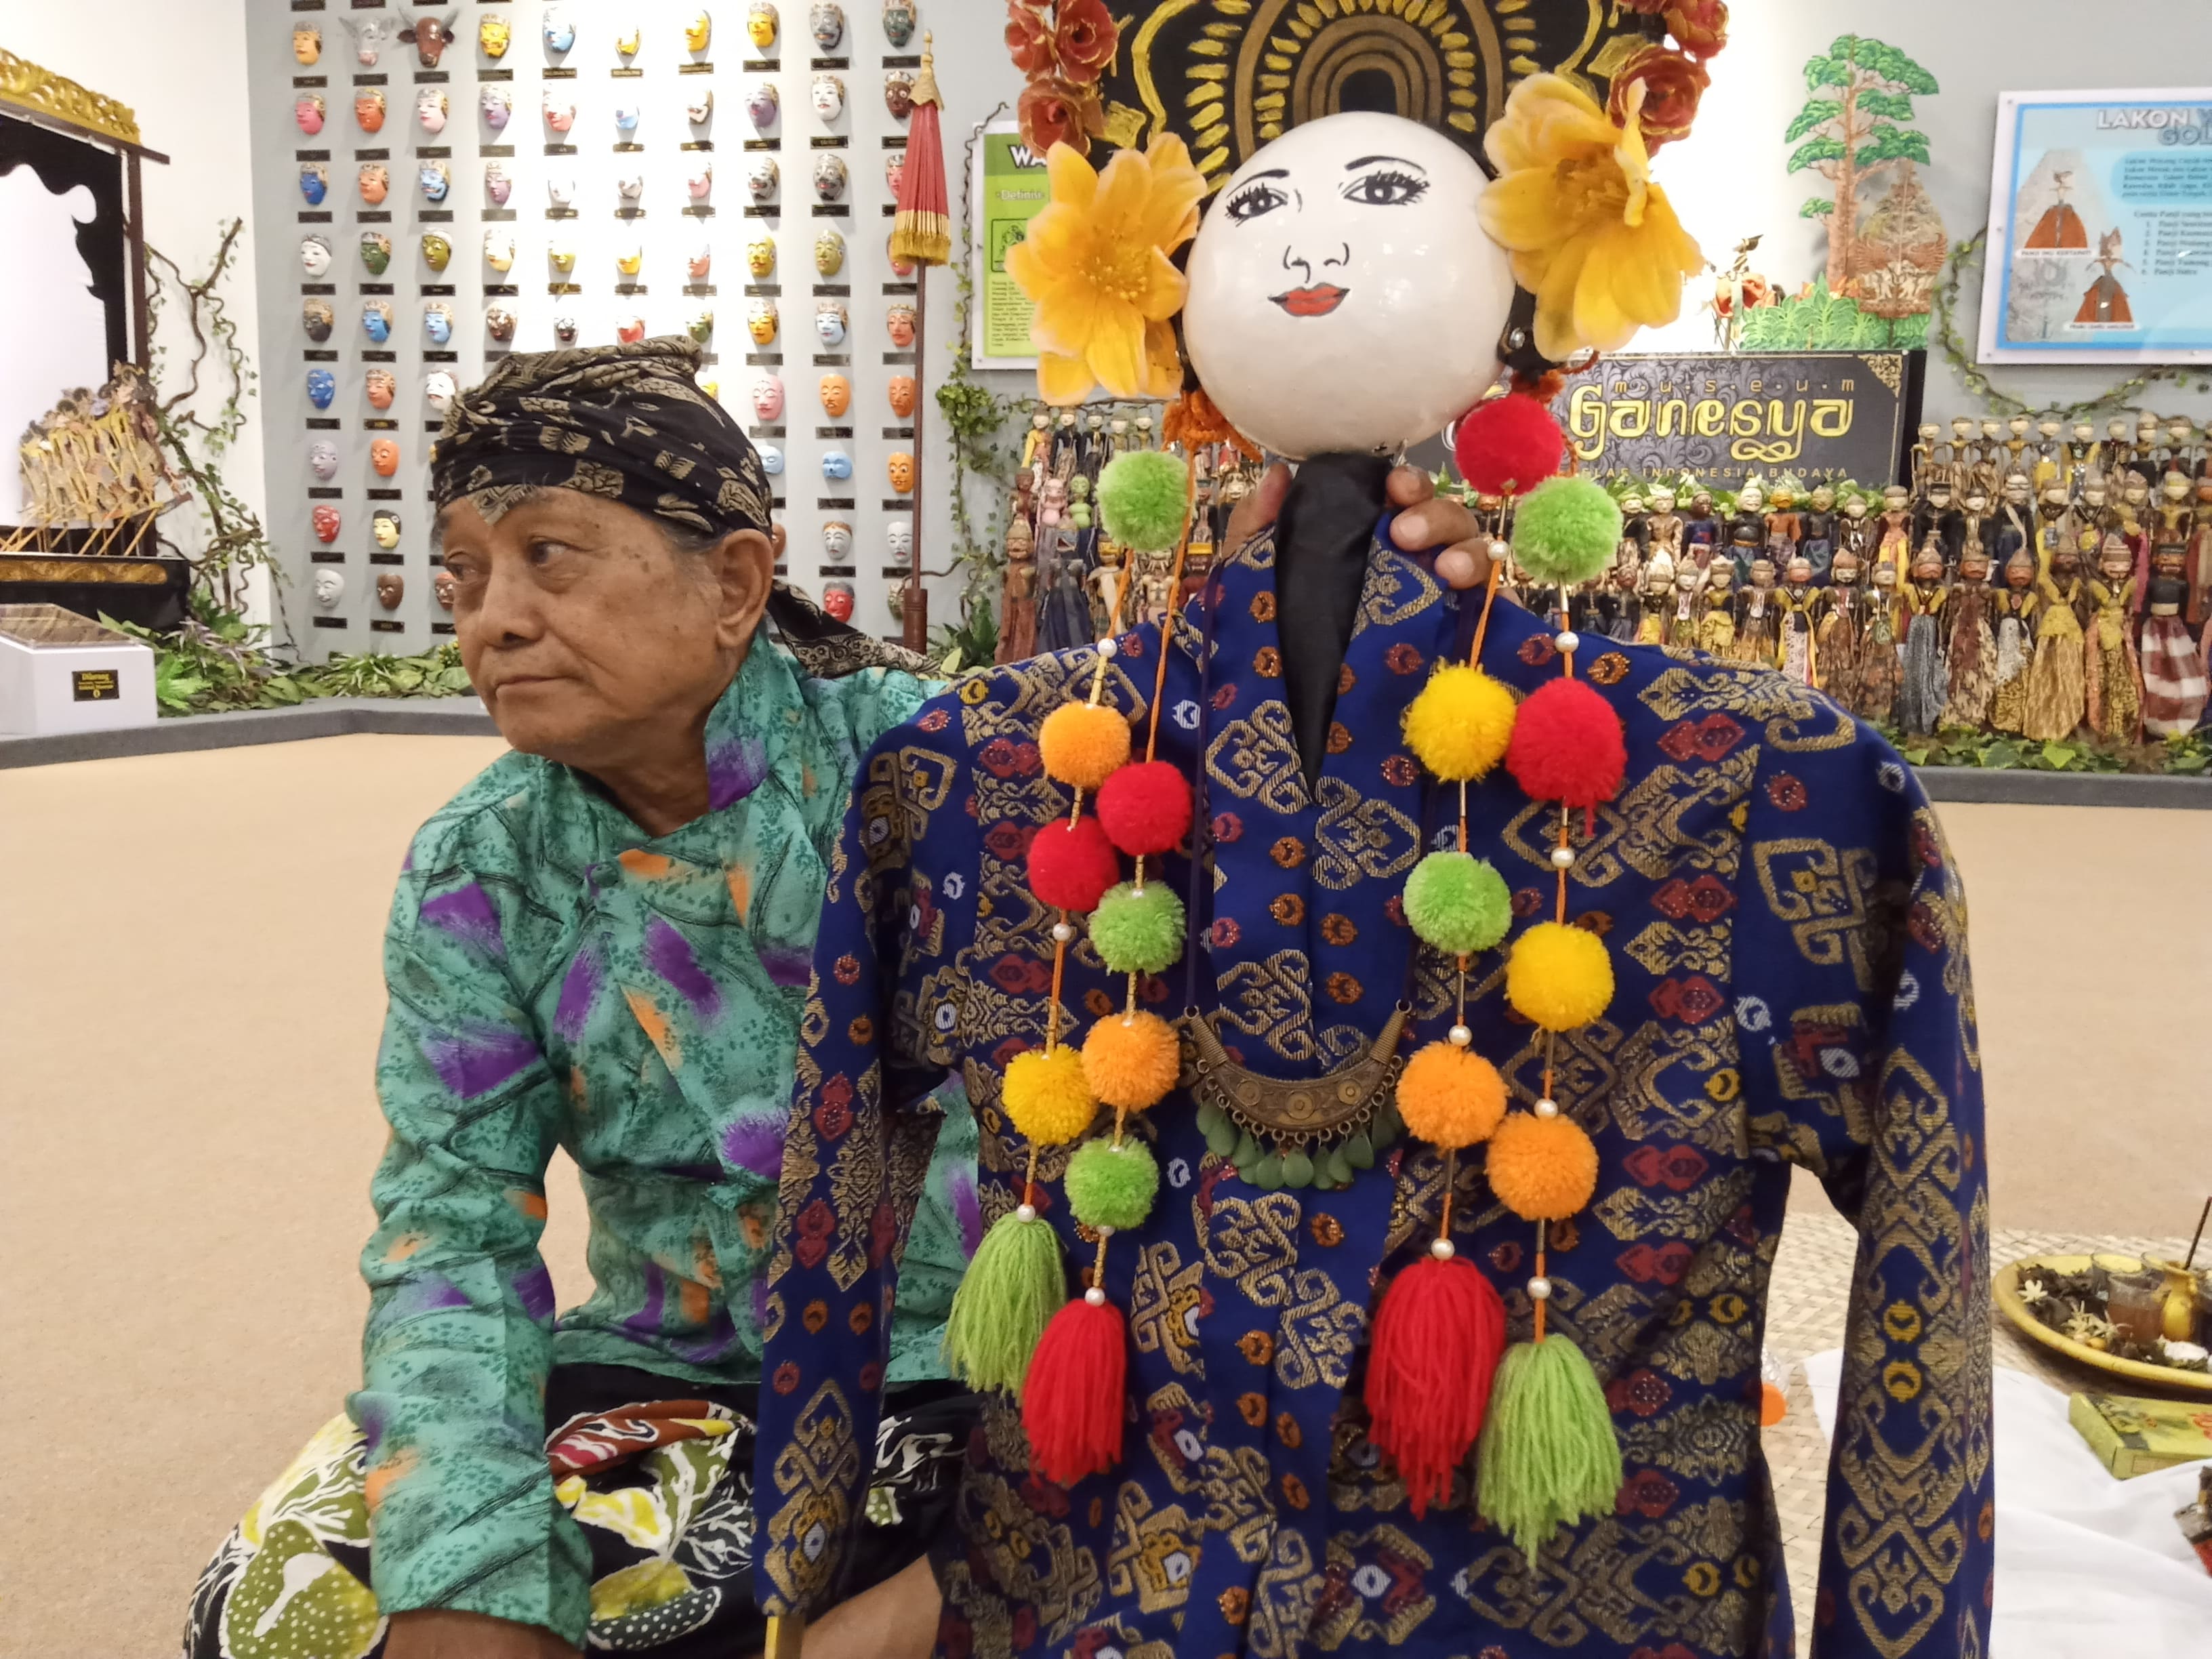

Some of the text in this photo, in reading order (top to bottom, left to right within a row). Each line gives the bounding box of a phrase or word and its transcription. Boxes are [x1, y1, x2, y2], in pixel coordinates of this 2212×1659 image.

[2096, 109, 2190, 129] LAKON
[1569, 384, 1854, 464] Ganesya
[1643, 467, 1755, 478] INDONESIA
